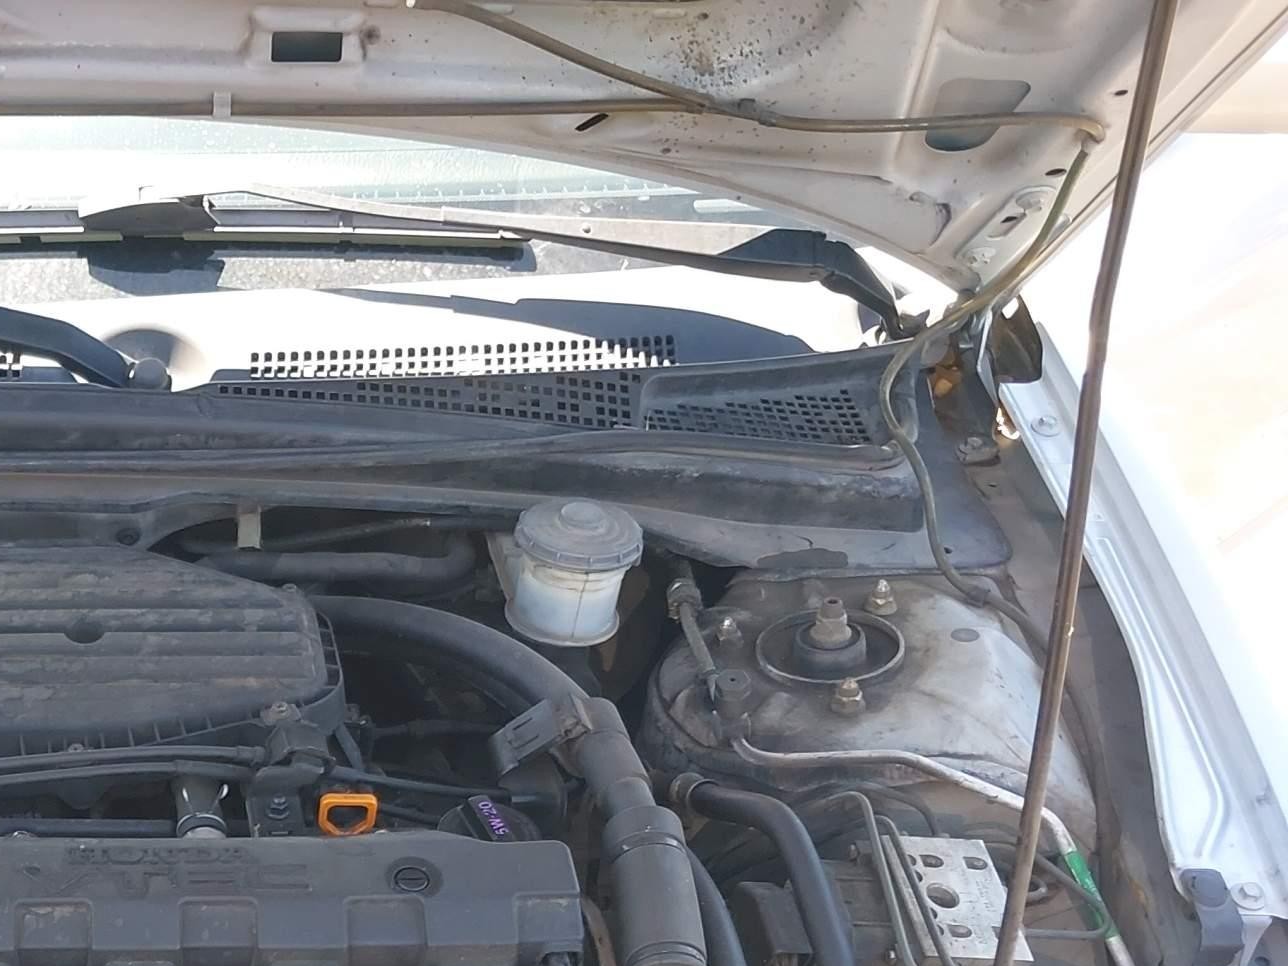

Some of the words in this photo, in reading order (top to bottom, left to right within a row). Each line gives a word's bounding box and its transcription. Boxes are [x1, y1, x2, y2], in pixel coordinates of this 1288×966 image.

[478, 801, 510, 835] 5W-20
[68, 847, 250, 865] HONDA
[23, 863, 312, 897] VTEC
